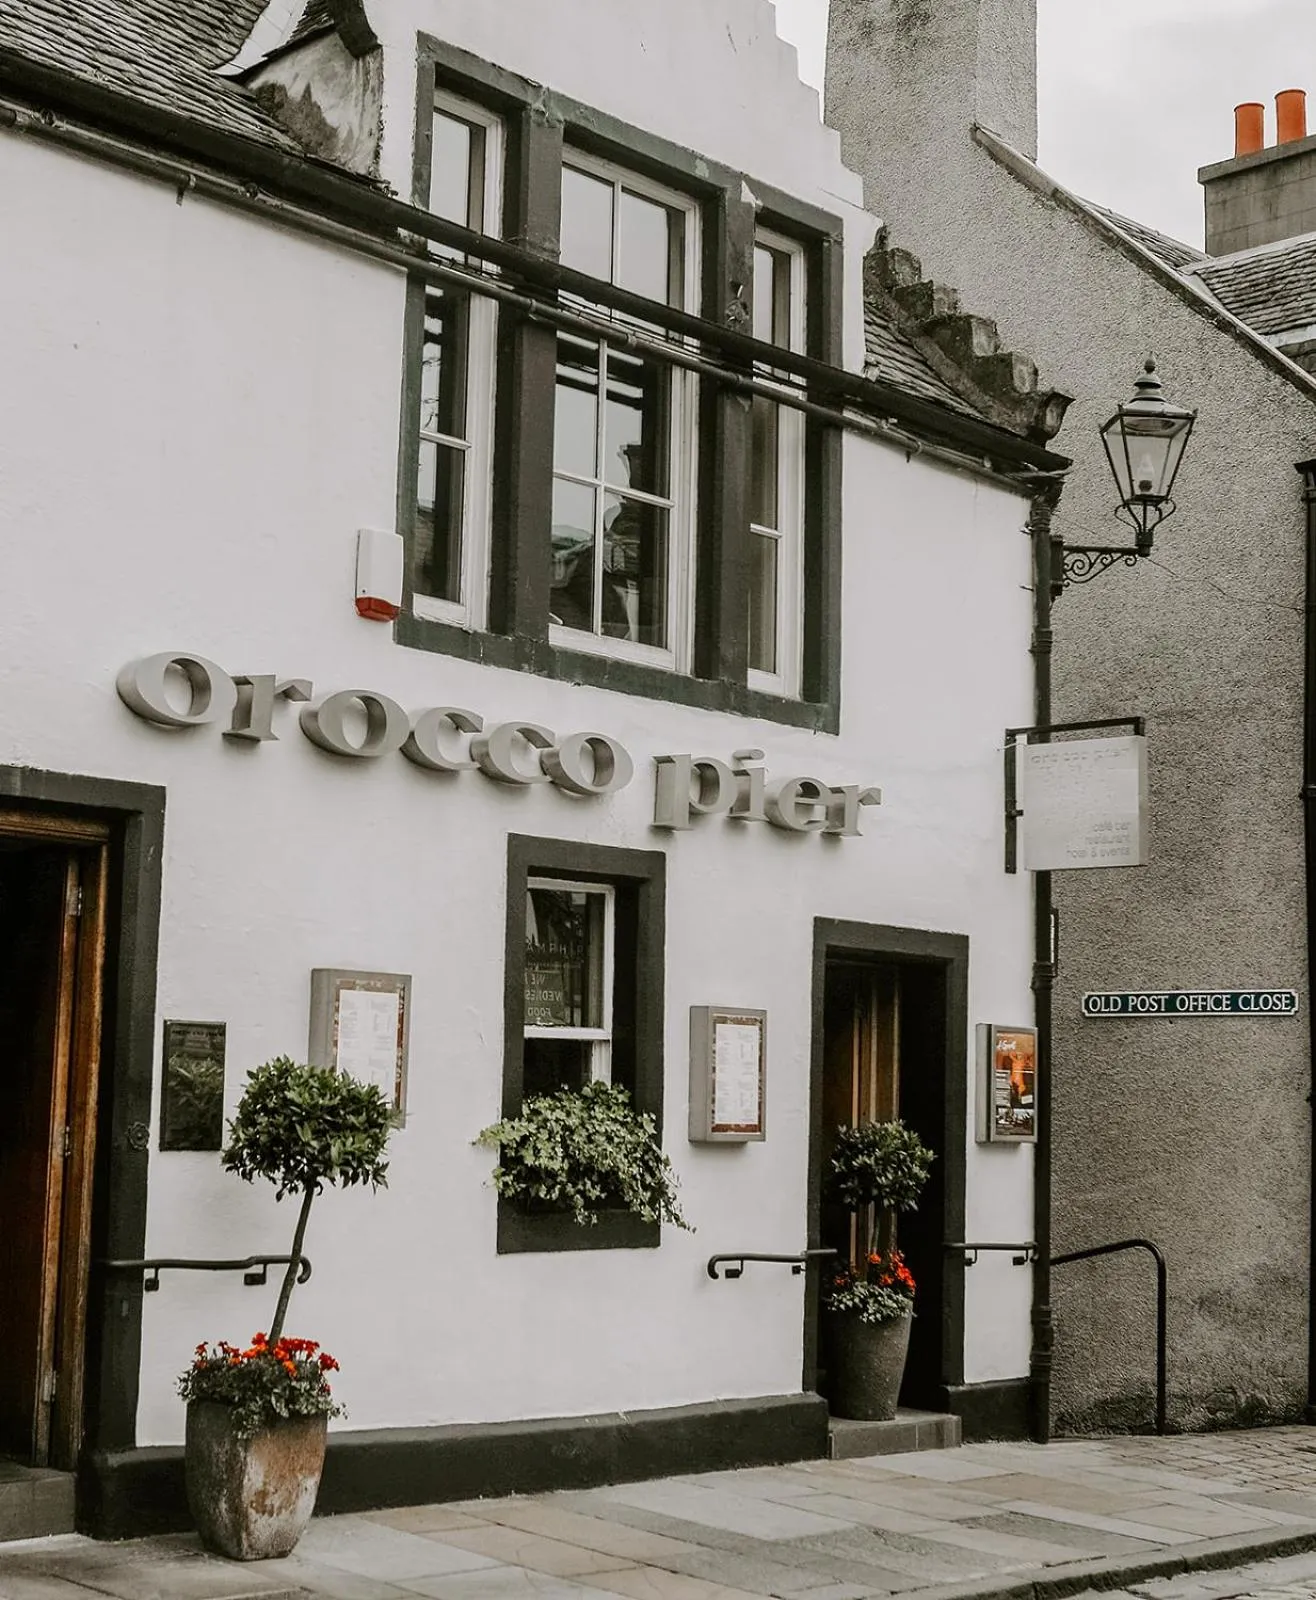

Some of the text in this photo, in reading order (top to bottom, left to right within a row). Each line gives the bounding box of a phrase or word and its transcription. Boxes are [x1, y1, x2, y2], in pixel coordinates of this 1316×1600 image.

[116, 651, 882, 836] orocco pier
[1089, 993, 1291, 1012] OLD POST OFFICE CLOSE
